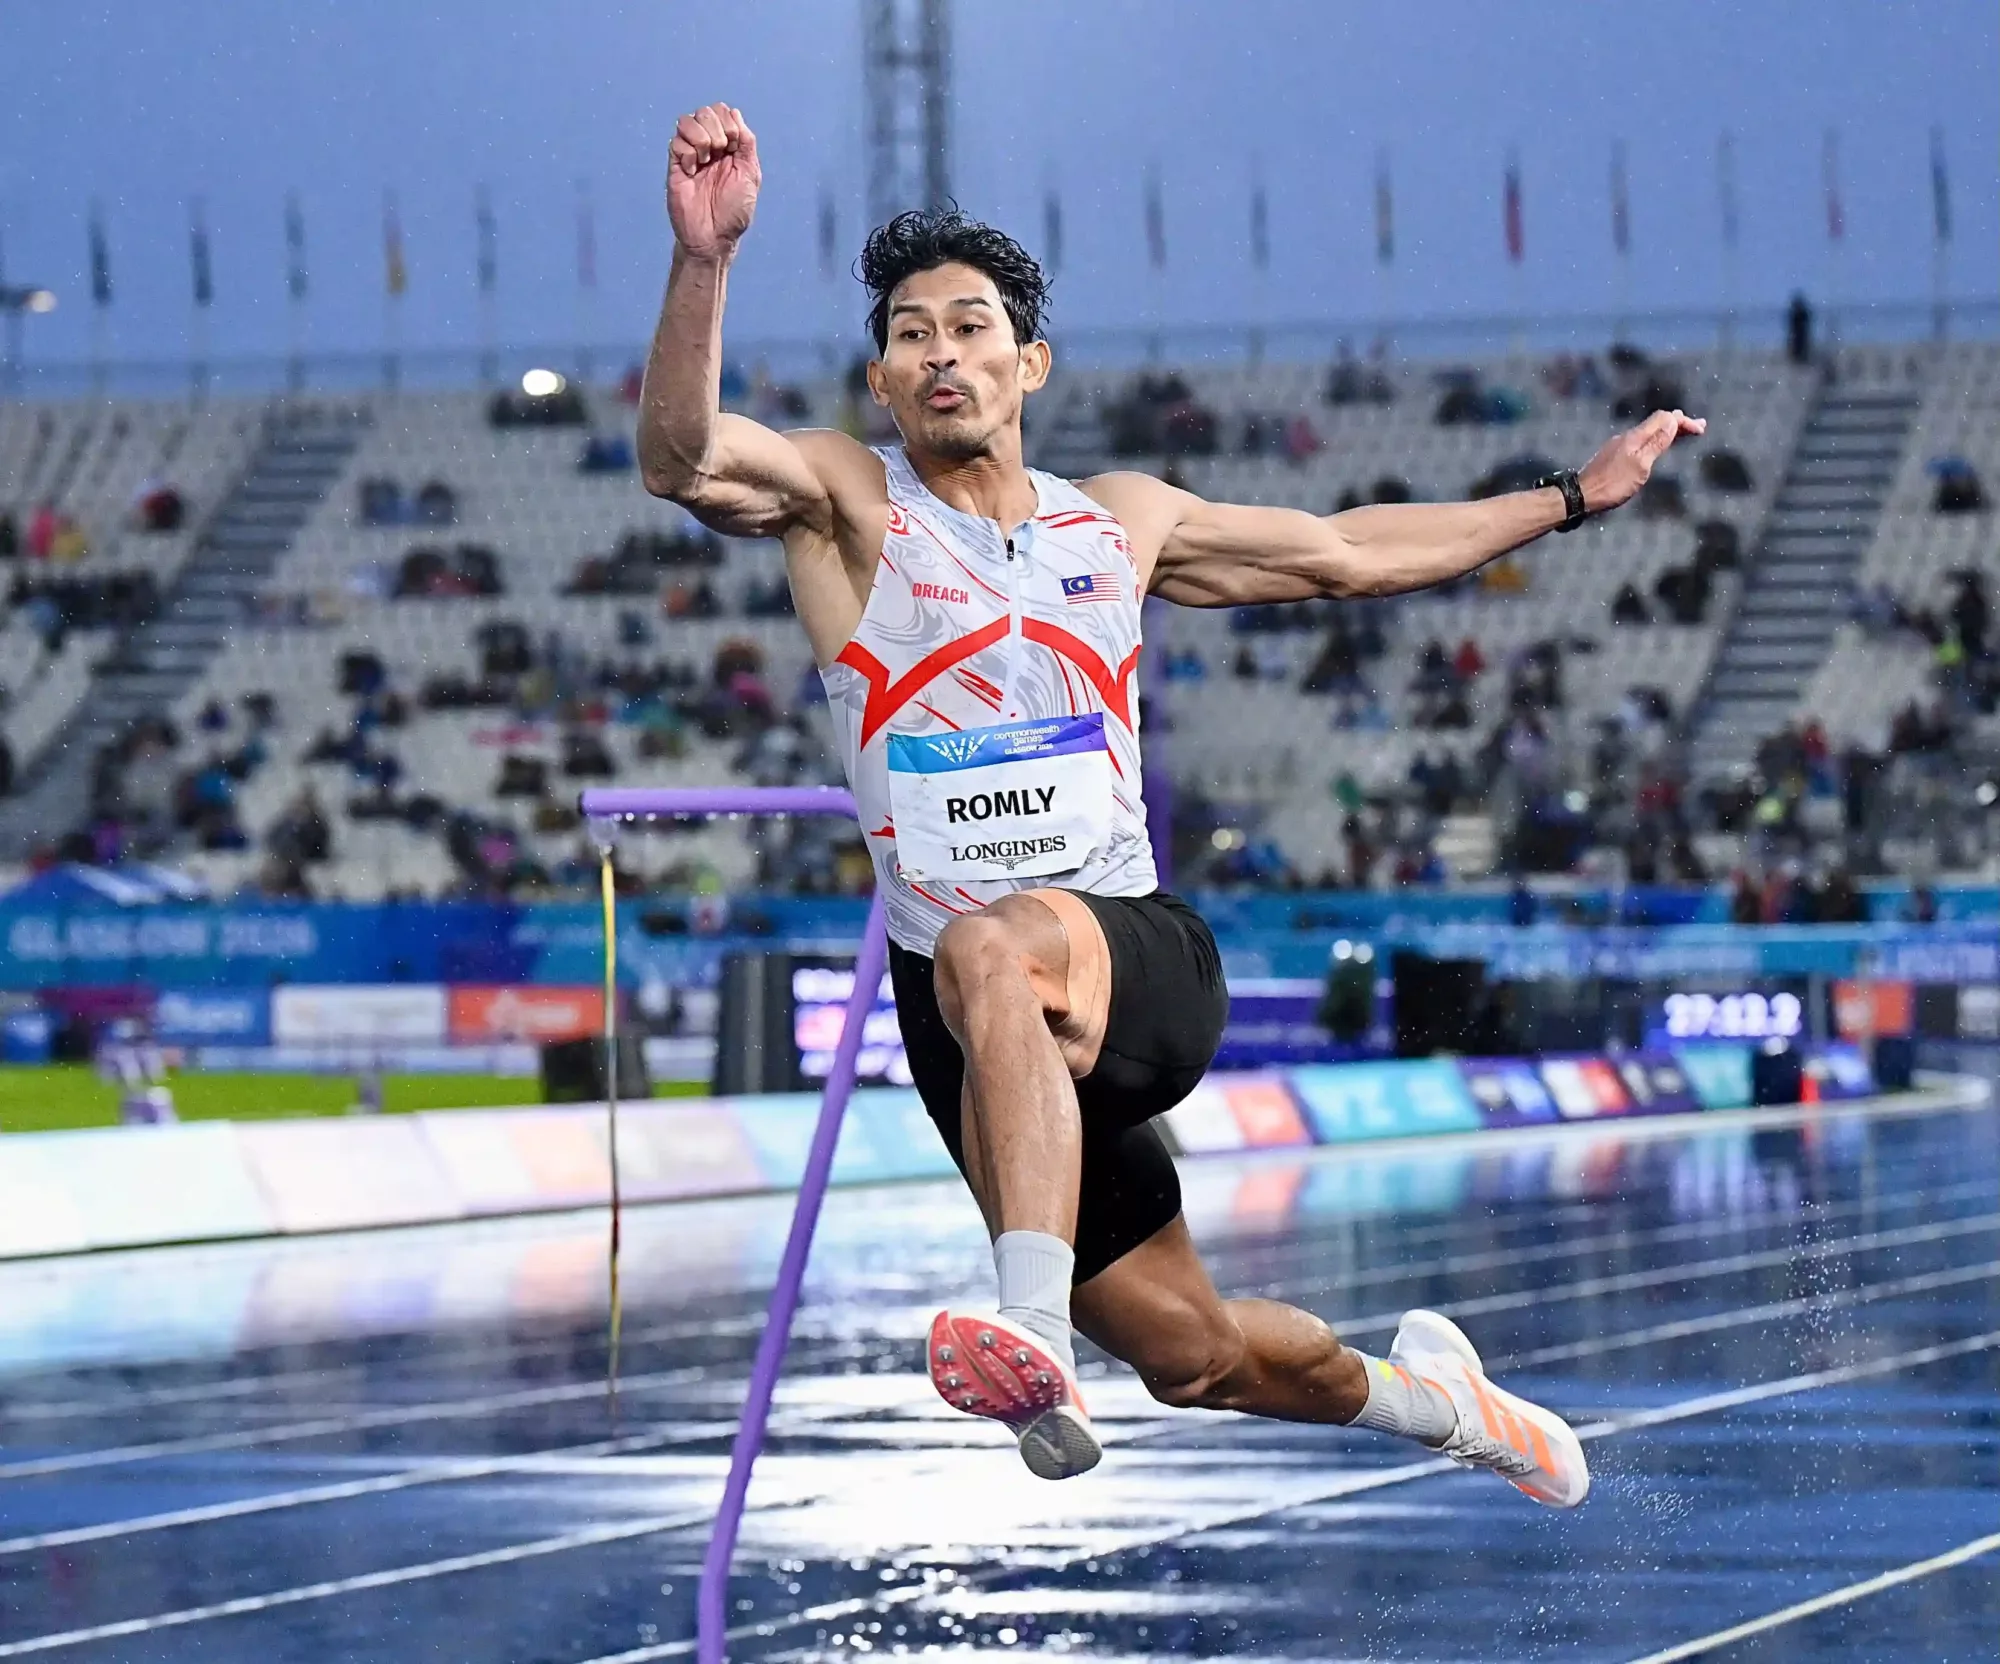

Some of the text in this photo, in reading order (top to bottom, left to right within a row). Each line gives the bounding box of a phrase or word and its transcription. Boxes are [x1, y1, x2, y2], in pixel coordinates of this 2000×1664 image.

[912, 583, 969, 604] DREACH
[946, 785, 1056, 824] ROMLY
[950, 835, 1067, 861] LONGINES
